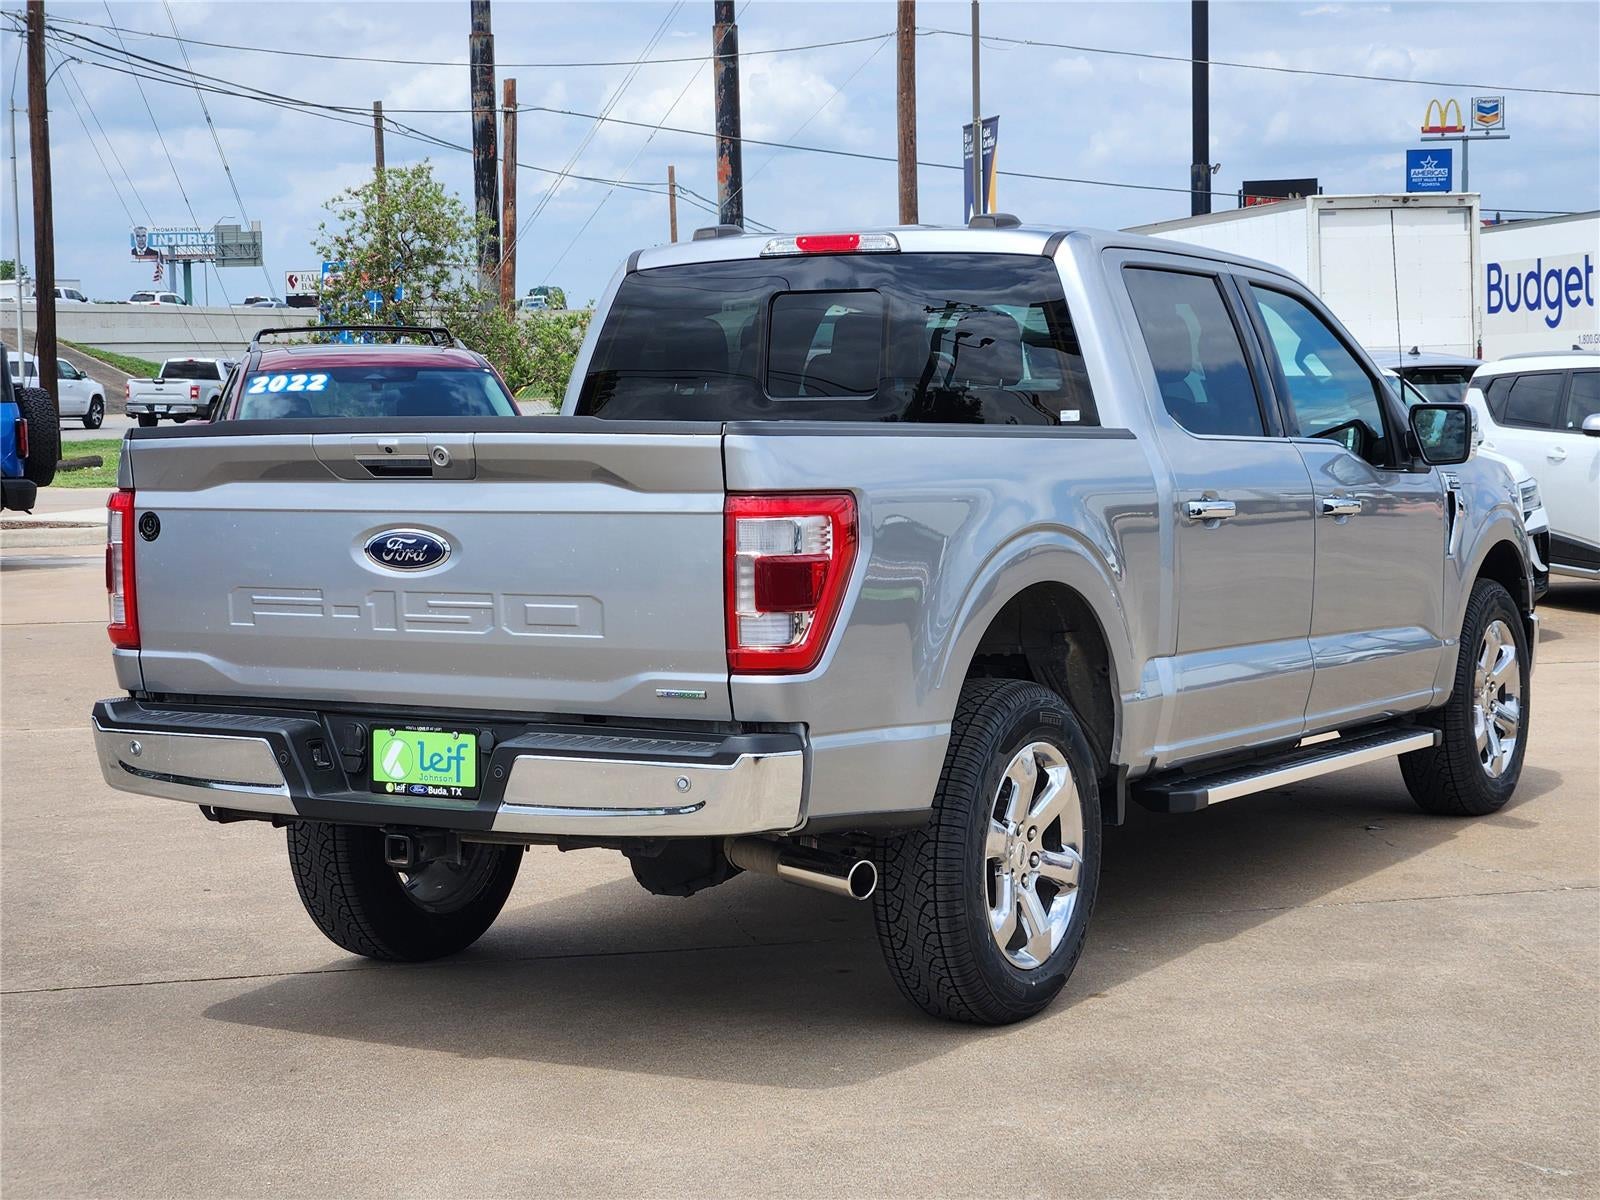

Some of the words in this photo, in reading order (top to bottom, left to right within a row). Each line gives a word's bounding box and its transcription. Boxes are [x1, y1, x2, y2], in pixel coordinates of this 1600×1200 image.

[1411, 169, 1448, 177] AMERICAS
[1487, 254, 1594, 329] Budget
[1578, 334, 1600, 345] 1.800.G
[247, 373, 328, 394] 2022
[382, 537, 428, 561] Ford
[230, 586, 605, 639] F-150
[418, 740, 468, 783] leif
[419, 773, 453, 782] Johnson
[428, 786, 449, 796] Buda,
[450, 787, 463, 796] TX
